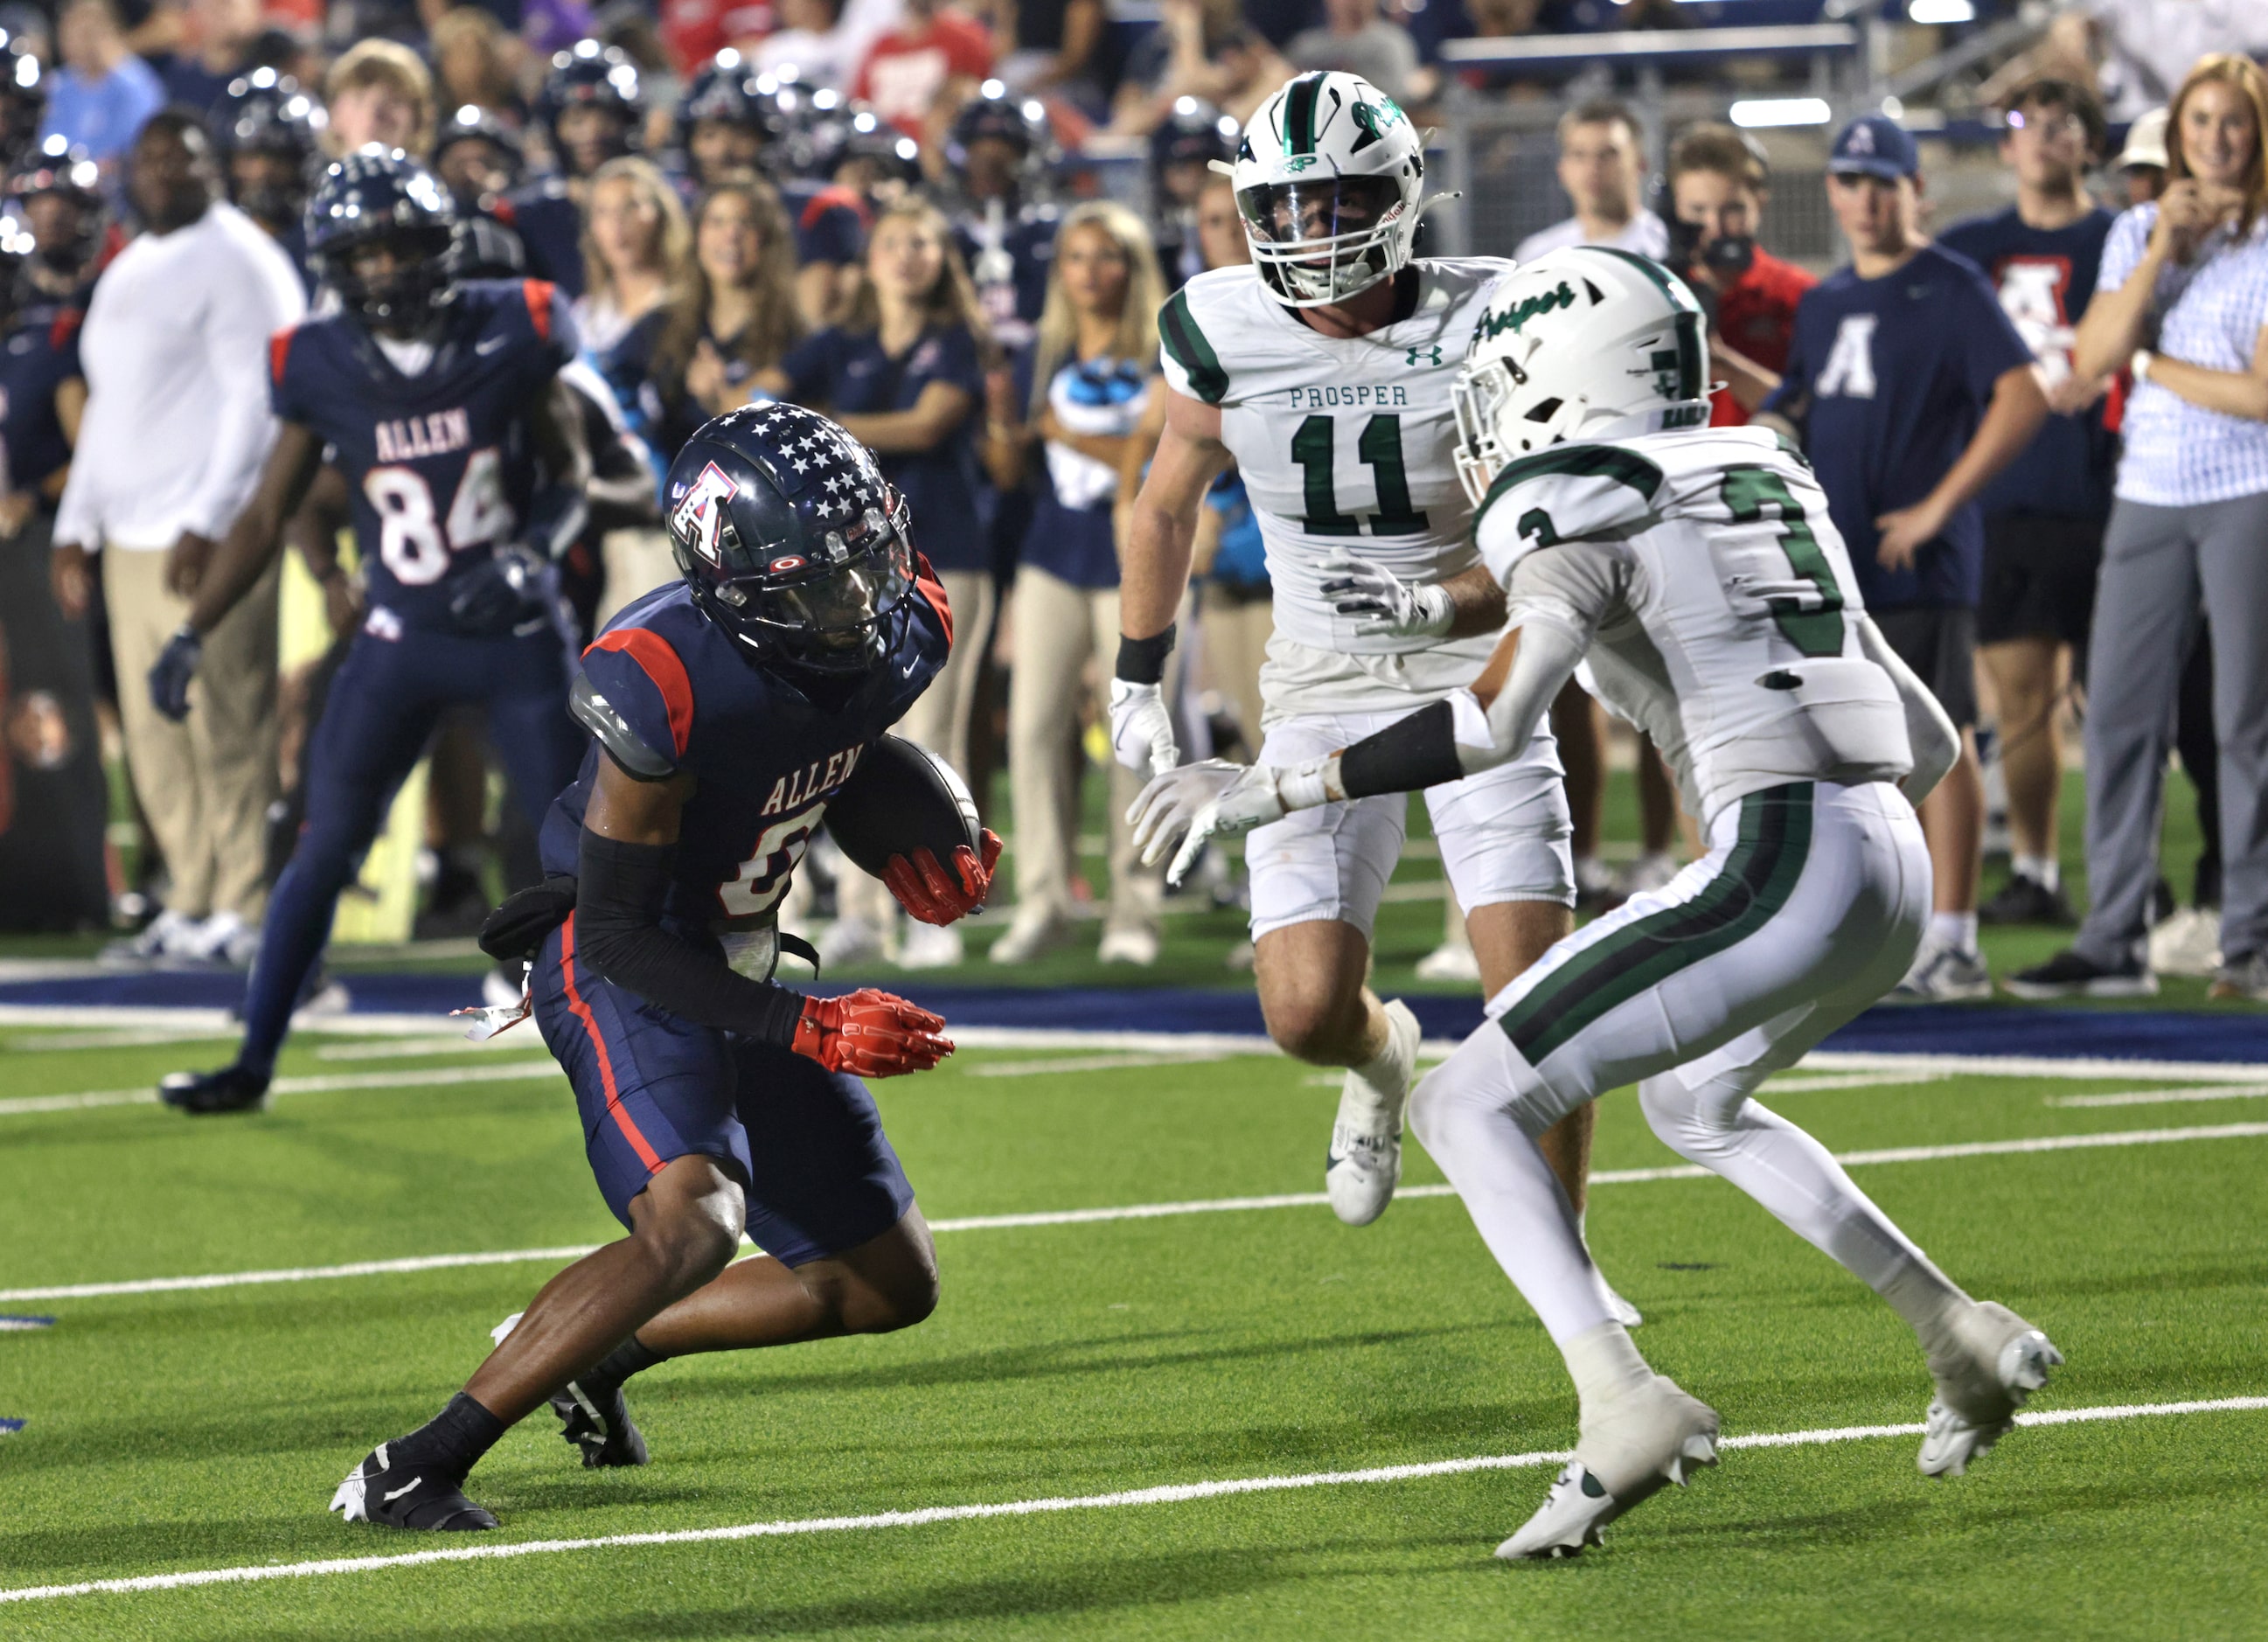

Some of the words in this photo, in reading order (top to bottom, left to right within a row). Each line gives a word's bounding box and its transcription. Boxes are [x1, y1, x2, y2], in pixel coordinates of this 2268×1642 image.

[1290, 385, 1409, 407] PROSPER
[1813, 312, 1878, 400] A
[375, 407, 470, 463] ALLEN
[1291, 414, 1430, 537] 11
[363, 446, 516, 585] 84
[670, 460, 741, 569] A
[760, 742, 865, 817] ALLEN
